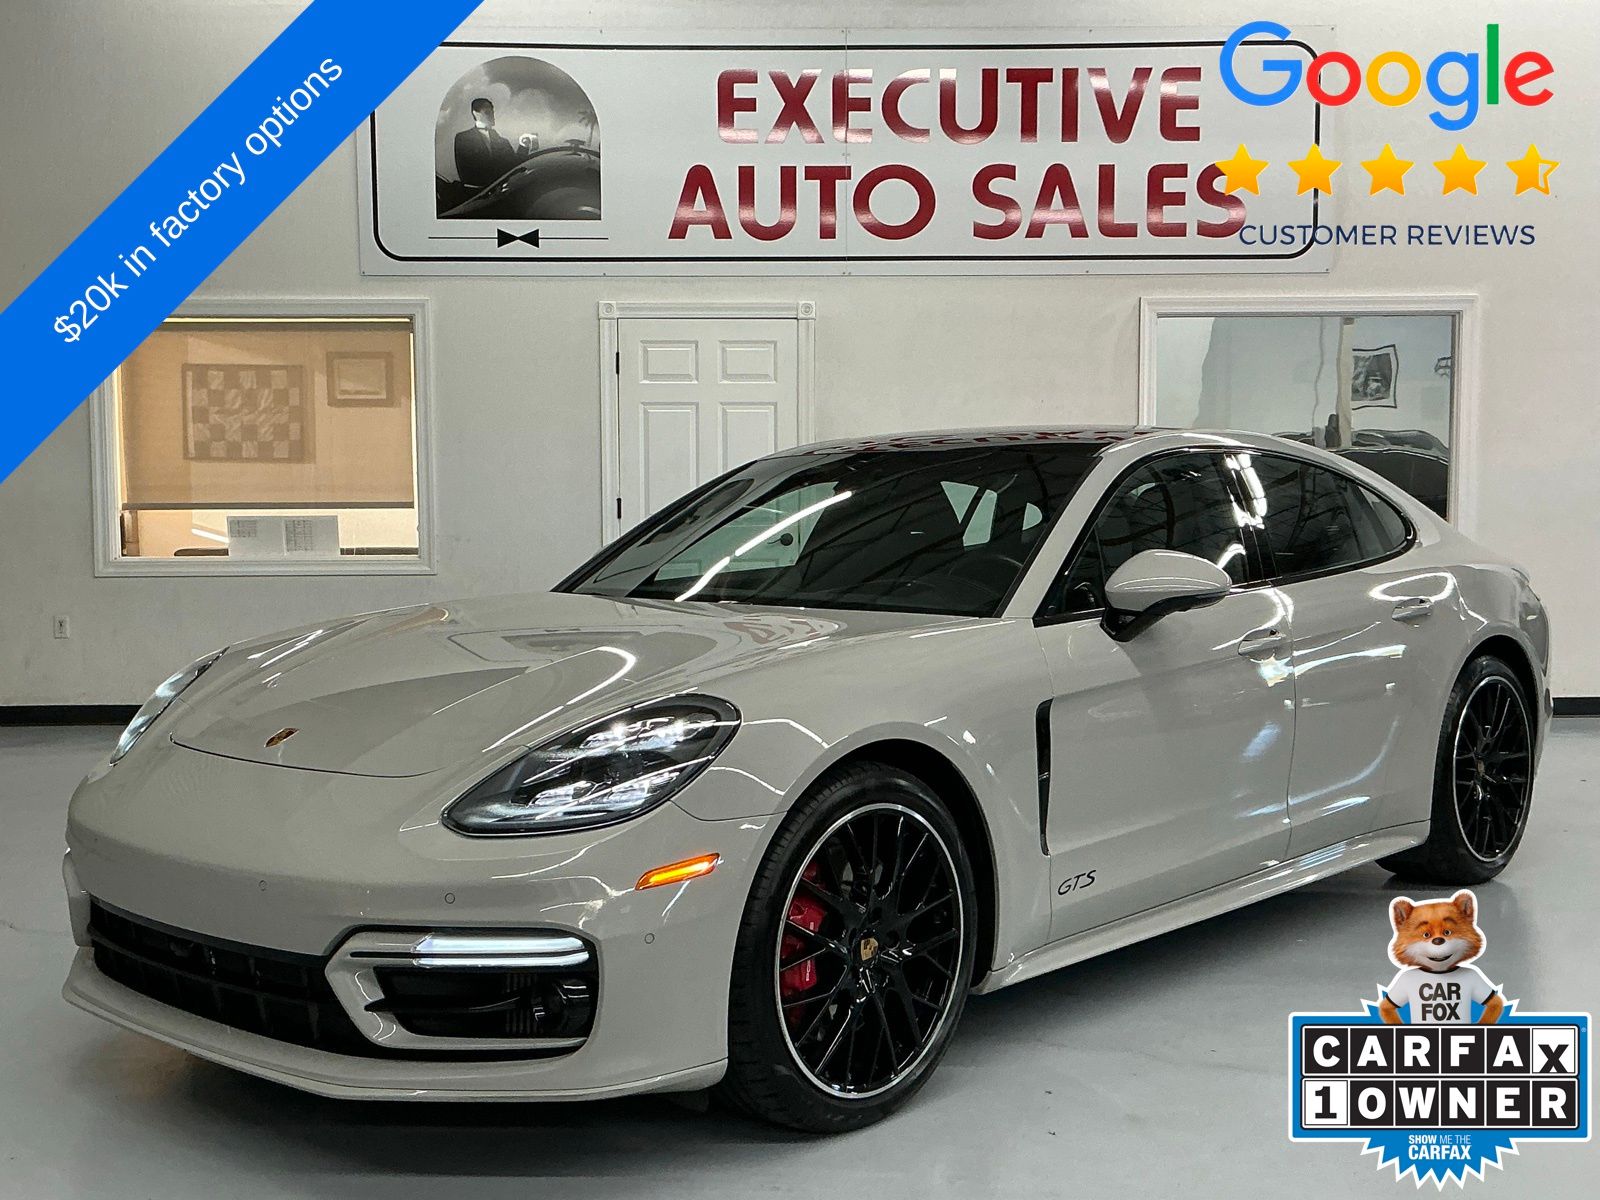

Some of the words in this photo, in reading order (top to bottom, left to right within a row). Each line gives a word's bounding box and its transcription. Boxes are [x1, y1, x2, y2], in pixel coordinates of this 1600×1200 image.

[716, 68, 1202, 144] EXECUTIVE
[668, 163, 936, 240] AUTO
[971, 163, 1248, 240] SALES
[1057, 869, 1097, 896] GTS
